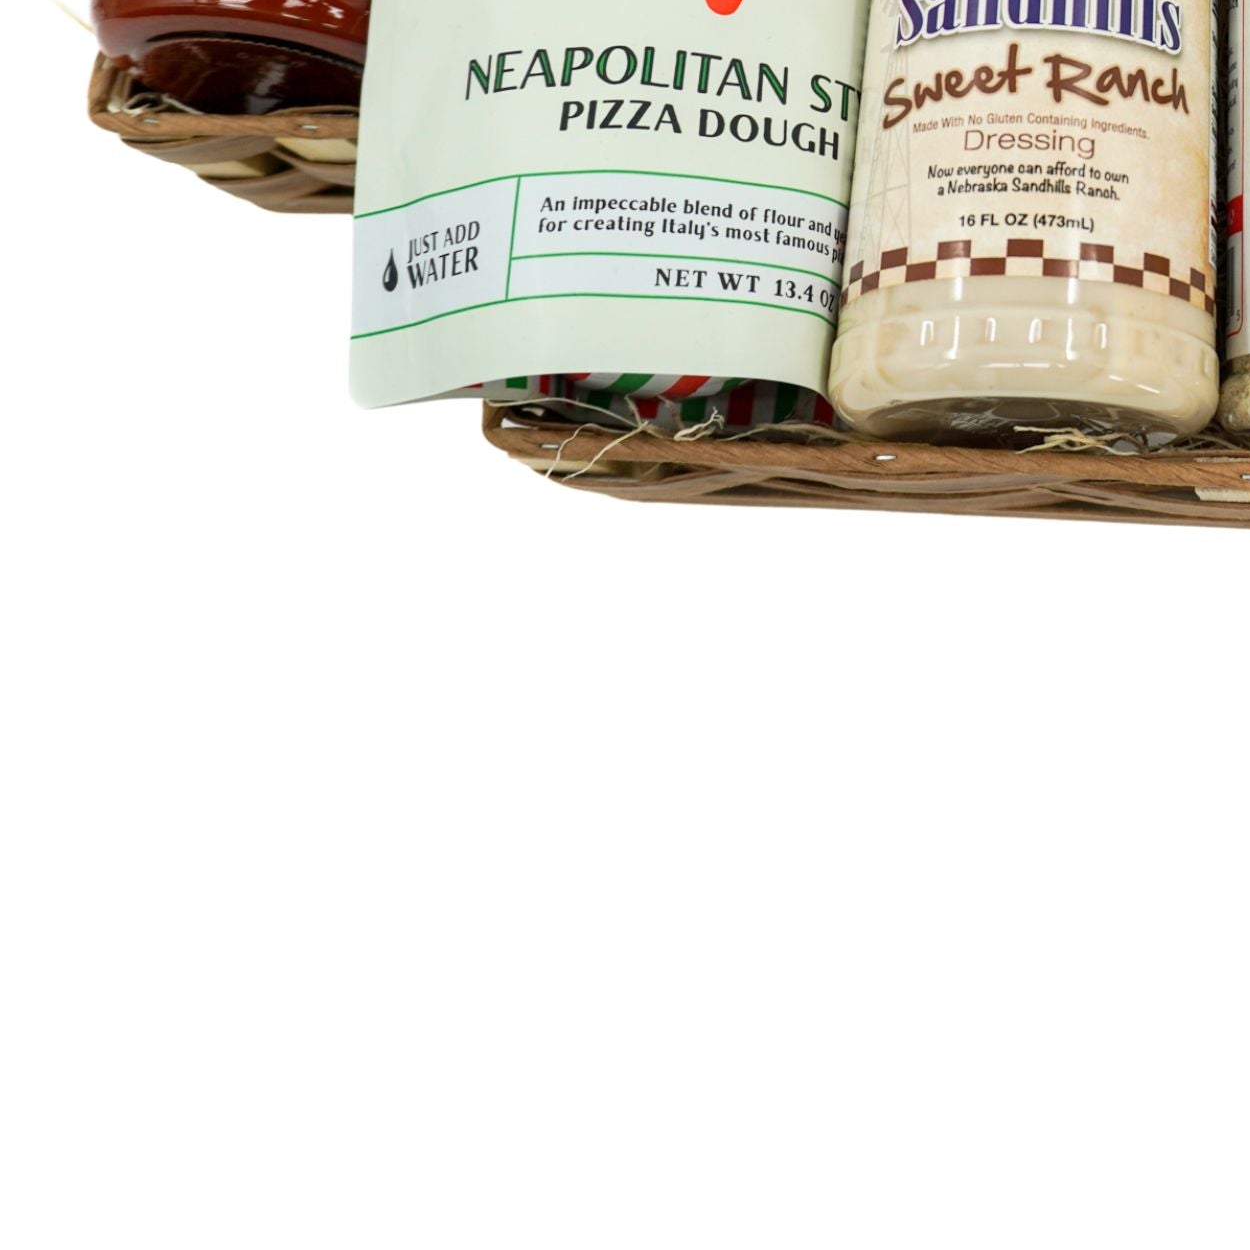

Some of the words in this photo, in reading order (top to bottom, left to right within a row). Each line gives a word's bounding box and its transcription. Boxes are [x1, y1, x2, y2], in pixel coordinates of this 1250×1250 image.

[464, 44, 789, 106] NEAPOLITAN
[882, 43, 1033, 130] Sweet
[1042, 54, 1190, 115] Ranch
[558, 98, 683, 134] PIZZA
[698, 108, 840, 161] DOUGH
[913, 121, 939, 134] Made
[941, 115, 964, 128] With
[967, 114, 983, 126] No
[986, 113, 1023, 126] Gluten
[1027, 113, 1088, 130] Containing
[1090, 117, 1150, 140] Ingredients.
[964, 129, 1096, 159] Dressing
[927, 165, 954, 180] Now
[957, 163, 1015, 180] everyone
[1018, 164, 1043, 175] can
[1046, 161, 1086, 179] afford
[1089, 167, 1101, 179] to
[1104, 172, 1129, 184] own
[937, 186, 945, 196] a
[948, 179, 1008, 195] Nebraska
[1011, 178, 1072, 195] Sandhills
[1075, 182, 1121, 201] Ranch.
[537, 217, 569, 234] for
[572, 214, 655, 239] creating
[661, 218, 720, 241] Italy's
[725, 225, 771, 244] most
[775, 229, 830, 256] famous
[539, 196, 566, 213] An
[572, 195, 679, 216] impeccable
[683, 199, 733, 220] blend
[738, 206, 759, 222] of
[762, 207, 805, 230] flour
[808, 219, 833, 237] and
[958, 215, 976, 228] 16
[980, 214, 999, 227] FL
[1004, 213, 1029, 228] OZ
[1033, 213, 1094, 233] (473mL)
[407, 232, 440, 264] JUST
[442, 220, 481, 250] ADD
[406, 246, 480, 290] WATER
[654, 267, 708, 289] NET
[717, 271, 761, 295] WT
[773, 278, 815, 305] 13.4
[819, 289, 836, 314] OZ
